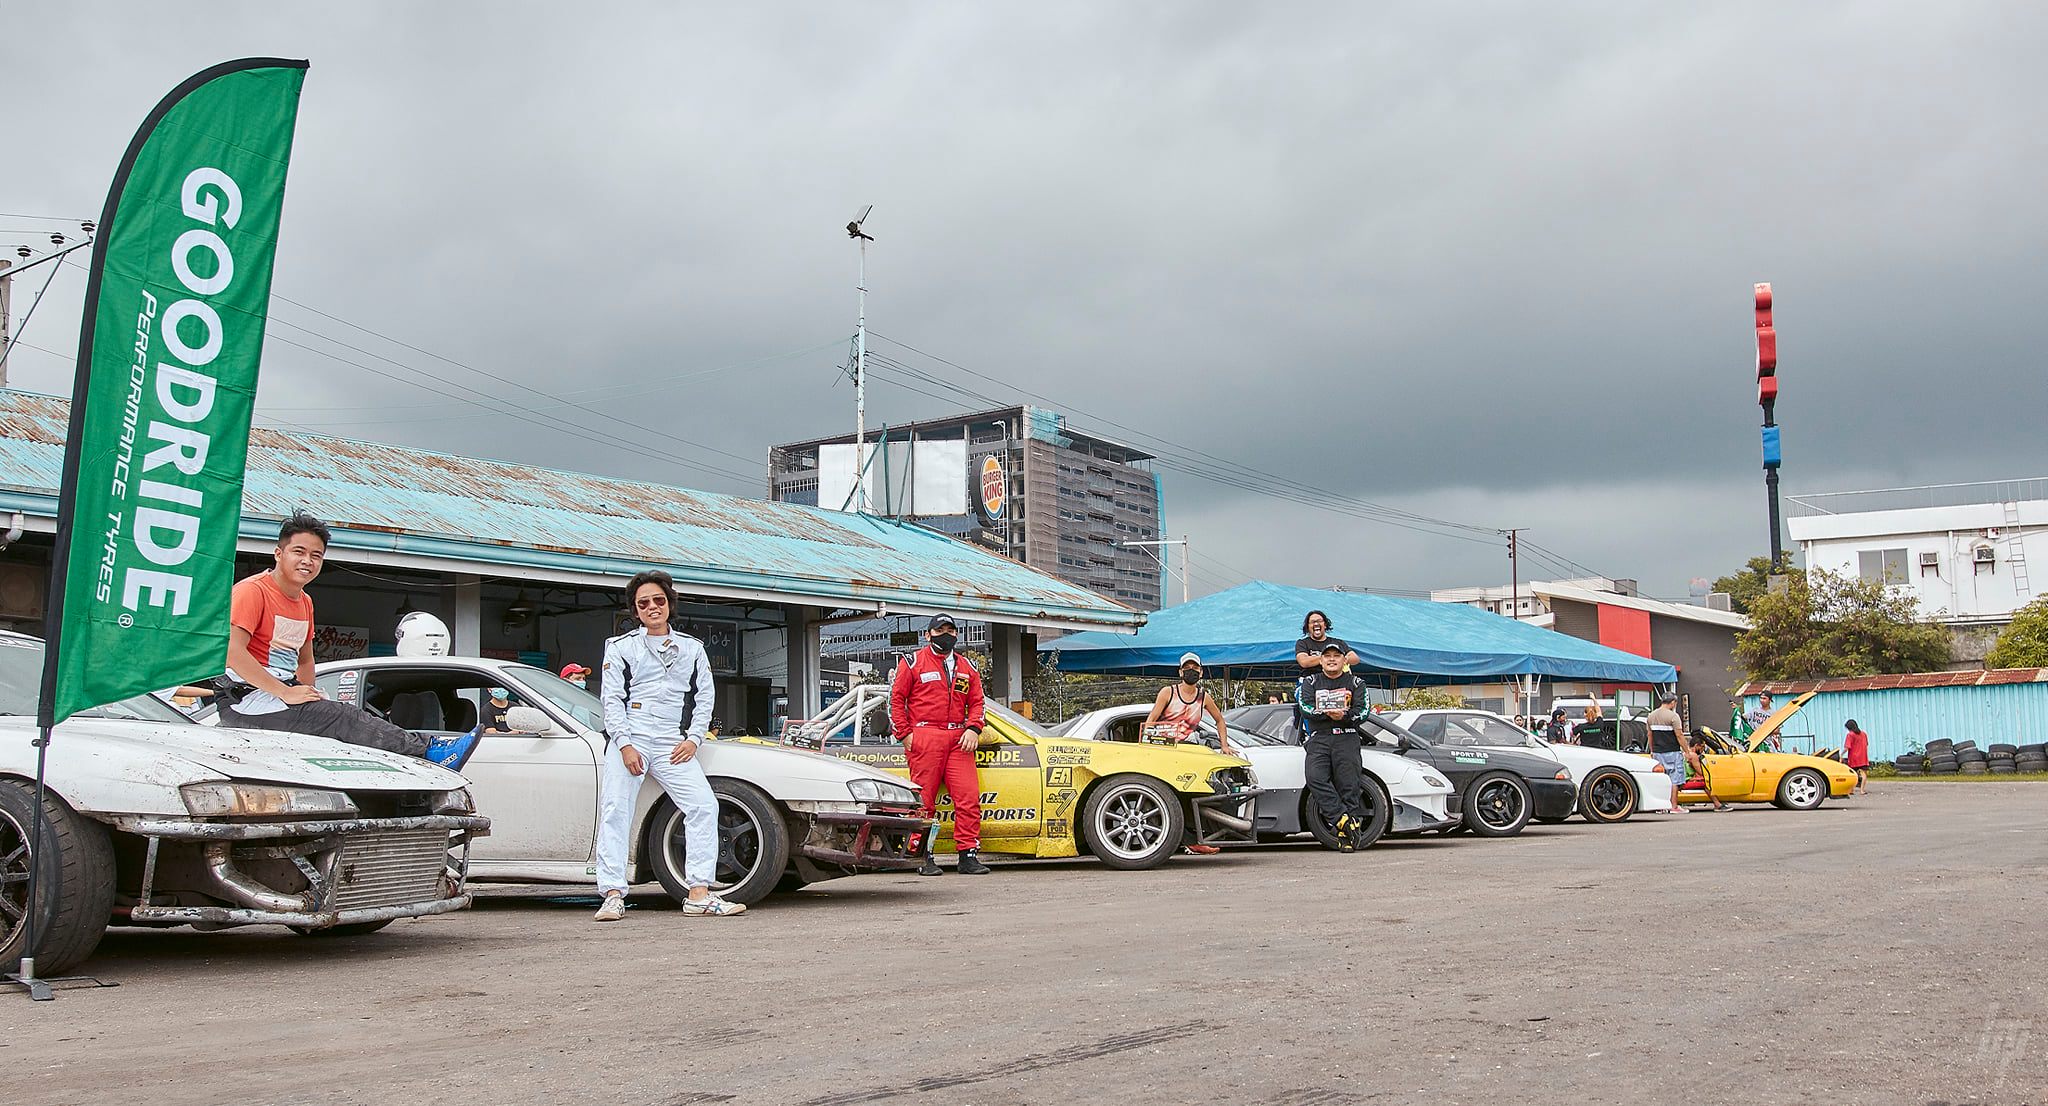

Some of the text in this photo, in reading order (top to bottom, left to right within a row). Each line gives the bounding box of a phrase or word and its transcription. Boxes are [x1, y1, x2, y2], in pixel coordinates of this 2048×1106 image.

[123, 167, 242, 616] GOODRIDE
[96, 289, 157, 604] PERFORMANCE TYRES
[983, 470, 1002, 485] BURGER
[984, 482, 1003, 503] KING
[1450, 750, 1475, 758] SPORT
